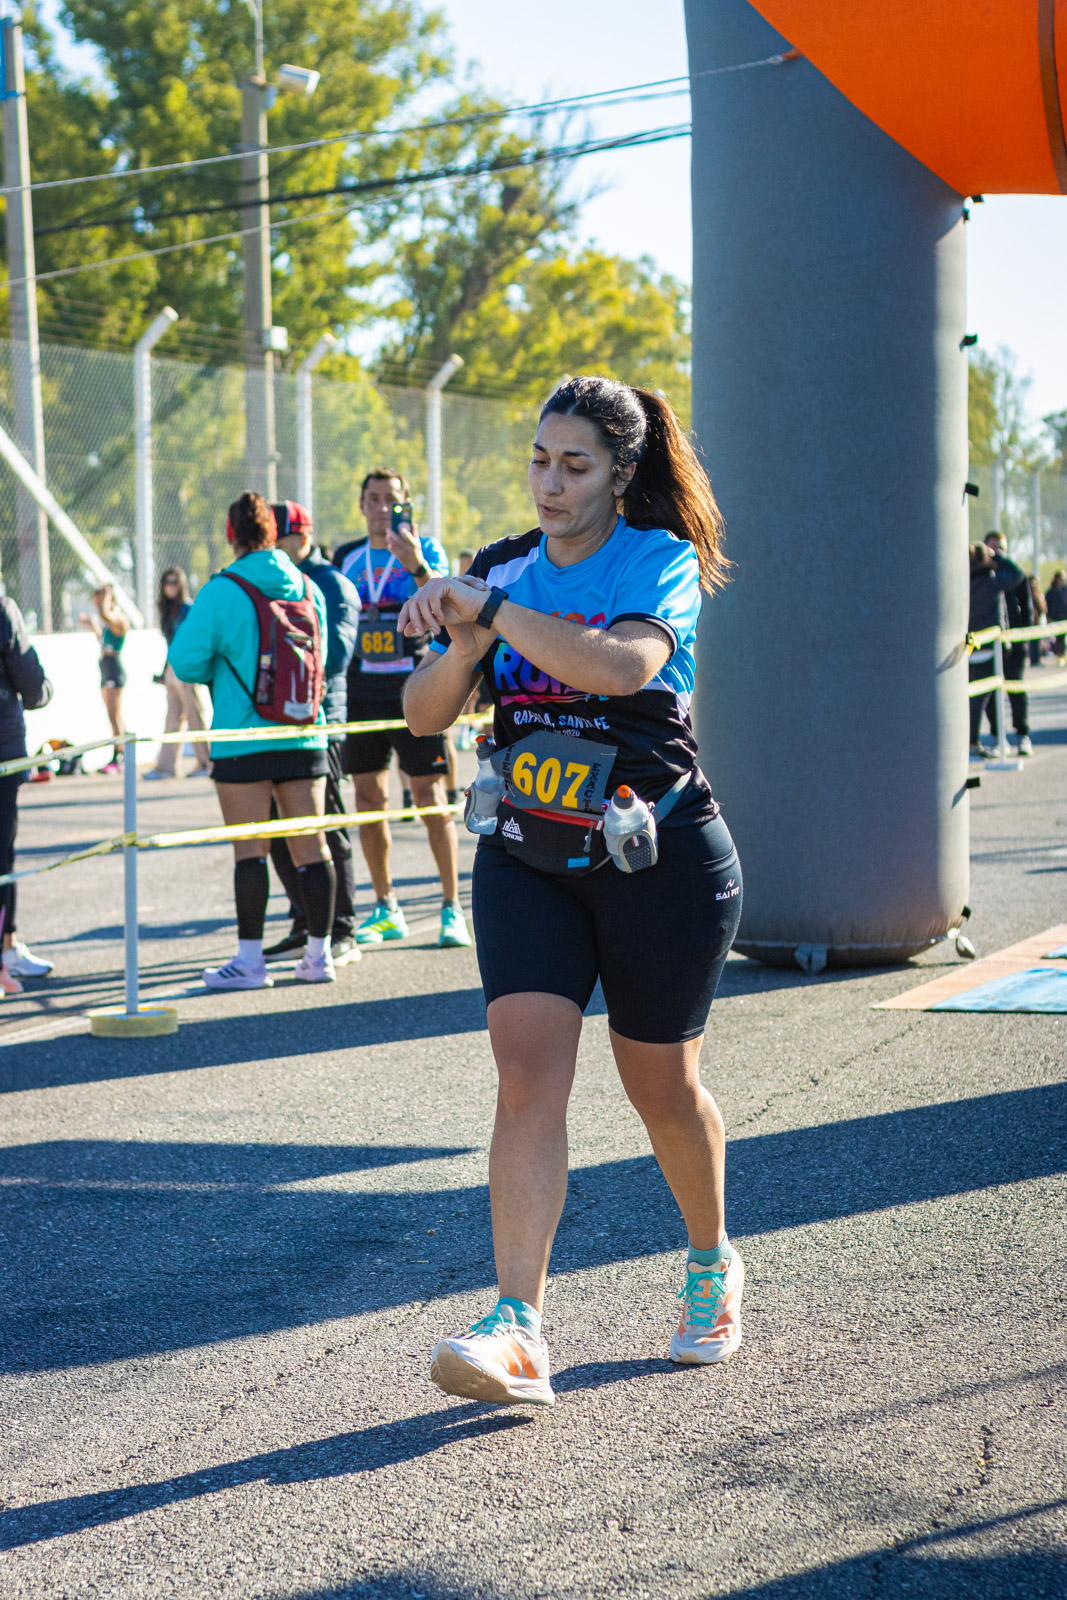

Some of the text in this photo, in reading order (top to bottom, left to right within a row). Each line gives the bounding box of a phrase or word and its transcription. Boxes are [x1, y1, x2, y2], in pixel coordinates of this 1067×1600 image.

[361, 631, 395, 654] 682
[593, 716, 611, 731] FE
[512, 752, 590, 808] 607
